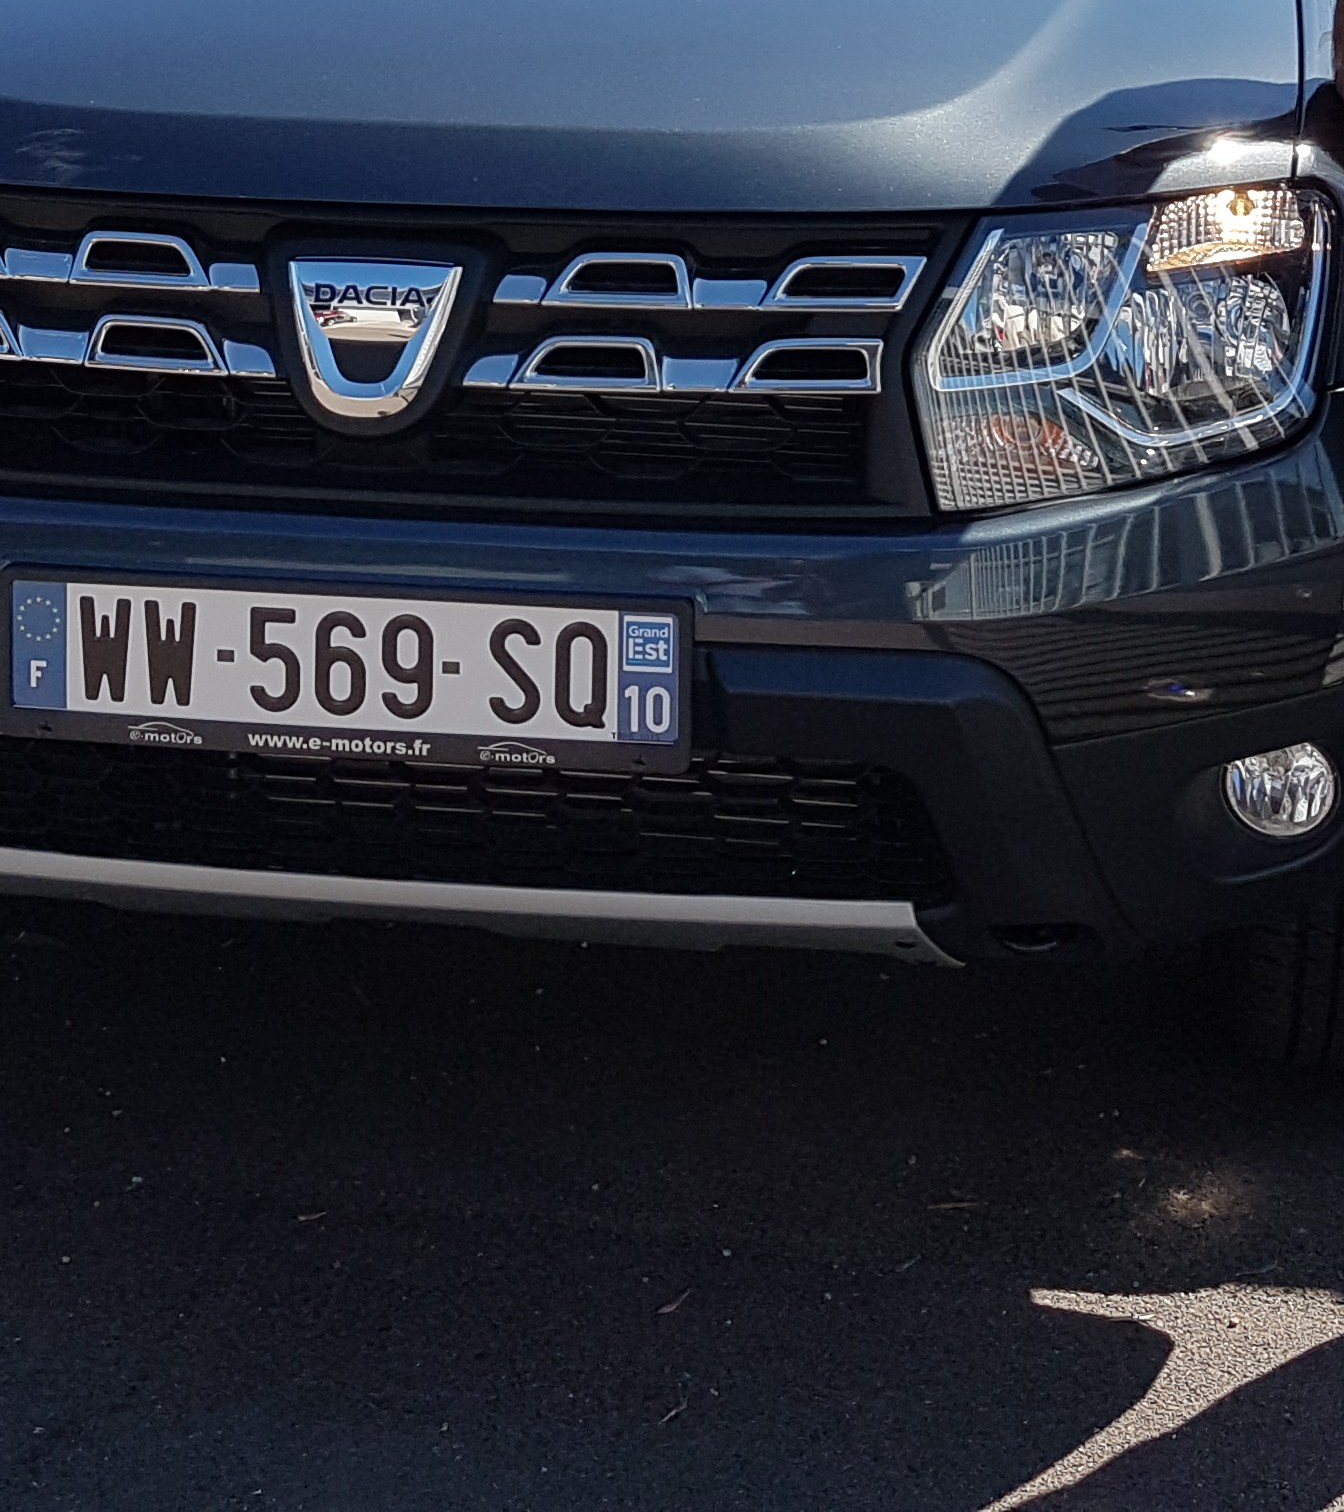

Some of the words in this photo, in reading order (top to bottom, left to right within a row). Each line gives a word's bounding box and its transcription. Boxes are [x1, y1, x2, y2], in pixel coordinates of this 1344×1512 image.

[314, 283, 426, 306] DACIA
[628, 626, 668, 638] Grand
[628, 638, 668, 660] Est
[30, 660, 47, 687] F
[79, 595, 608, 729] WW-569-SQ
[624, 685, 671, 734] 10
[248, 733, 431, 756] www.e-motors.fr
